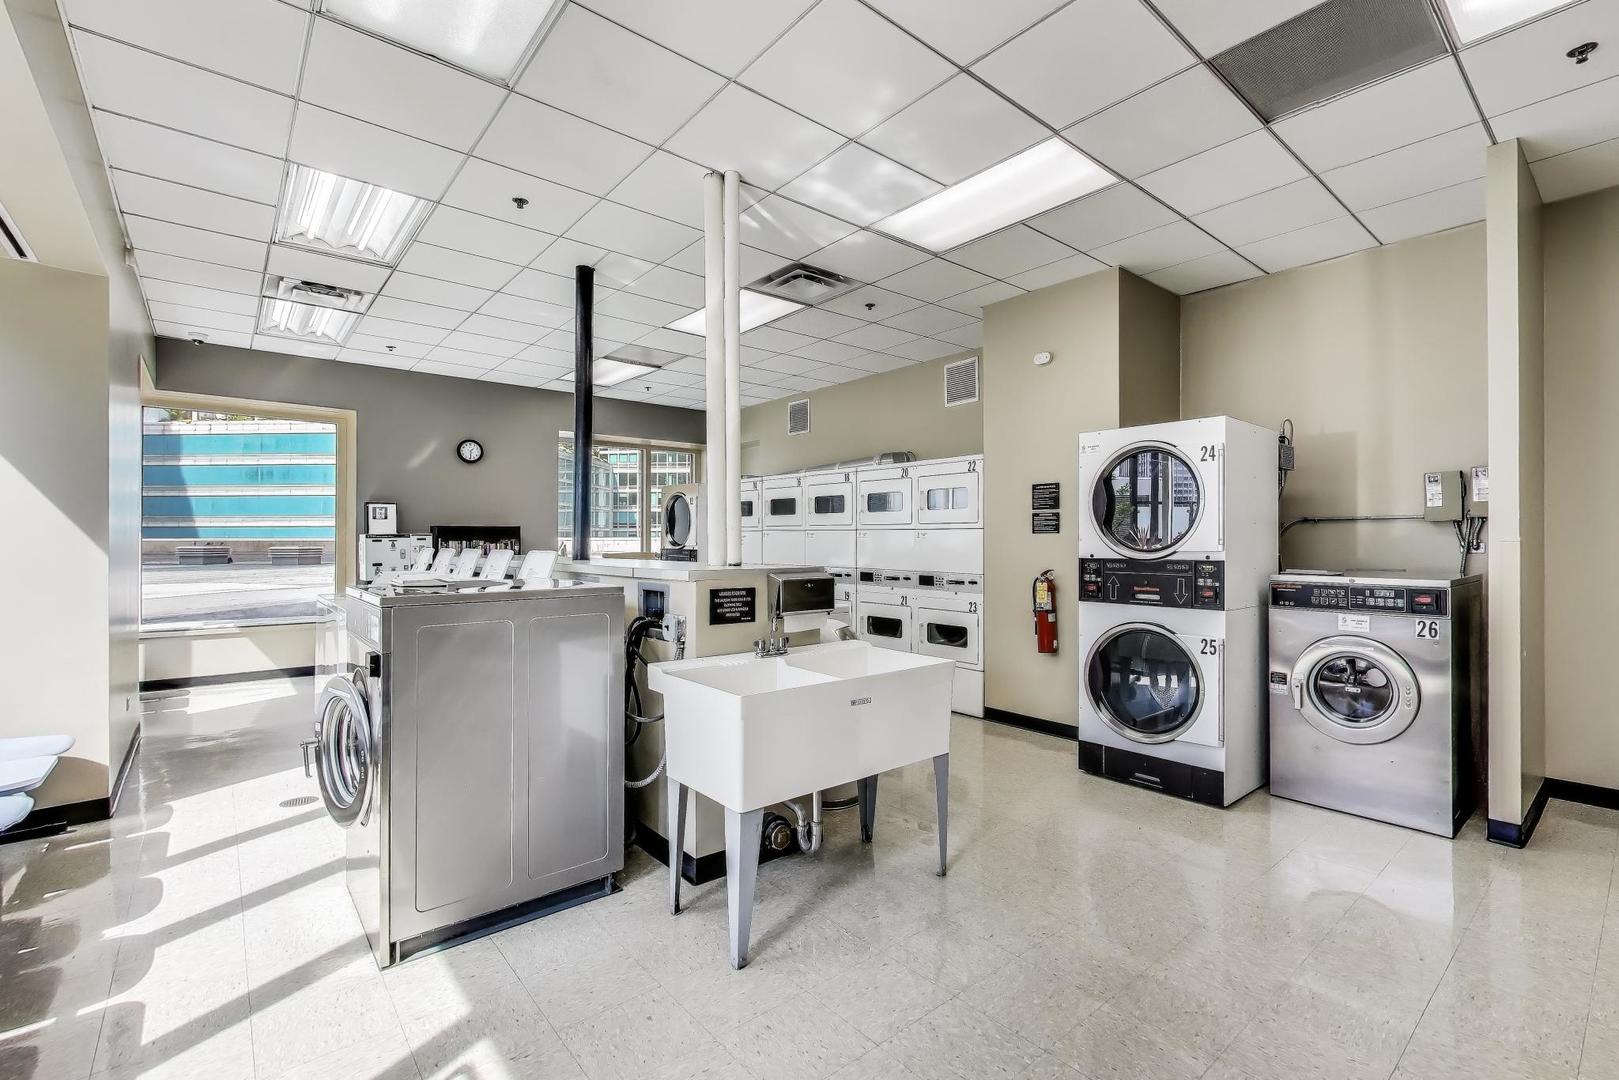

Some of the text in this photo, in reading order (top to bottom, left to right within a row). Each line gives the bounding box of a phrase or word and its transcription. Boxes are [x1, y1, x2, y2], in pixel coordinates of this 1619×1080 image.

[1200, 445, 1217, 462] 24
[967, 460, 977, 472] 22
[901, 467, 909, 478] 20
[900, 595, 908, 606] 21
[968, 601, 978, 613] 23
[1416, 620, 1438, 639] 26
[1200, 638, 1217, 656] 25
